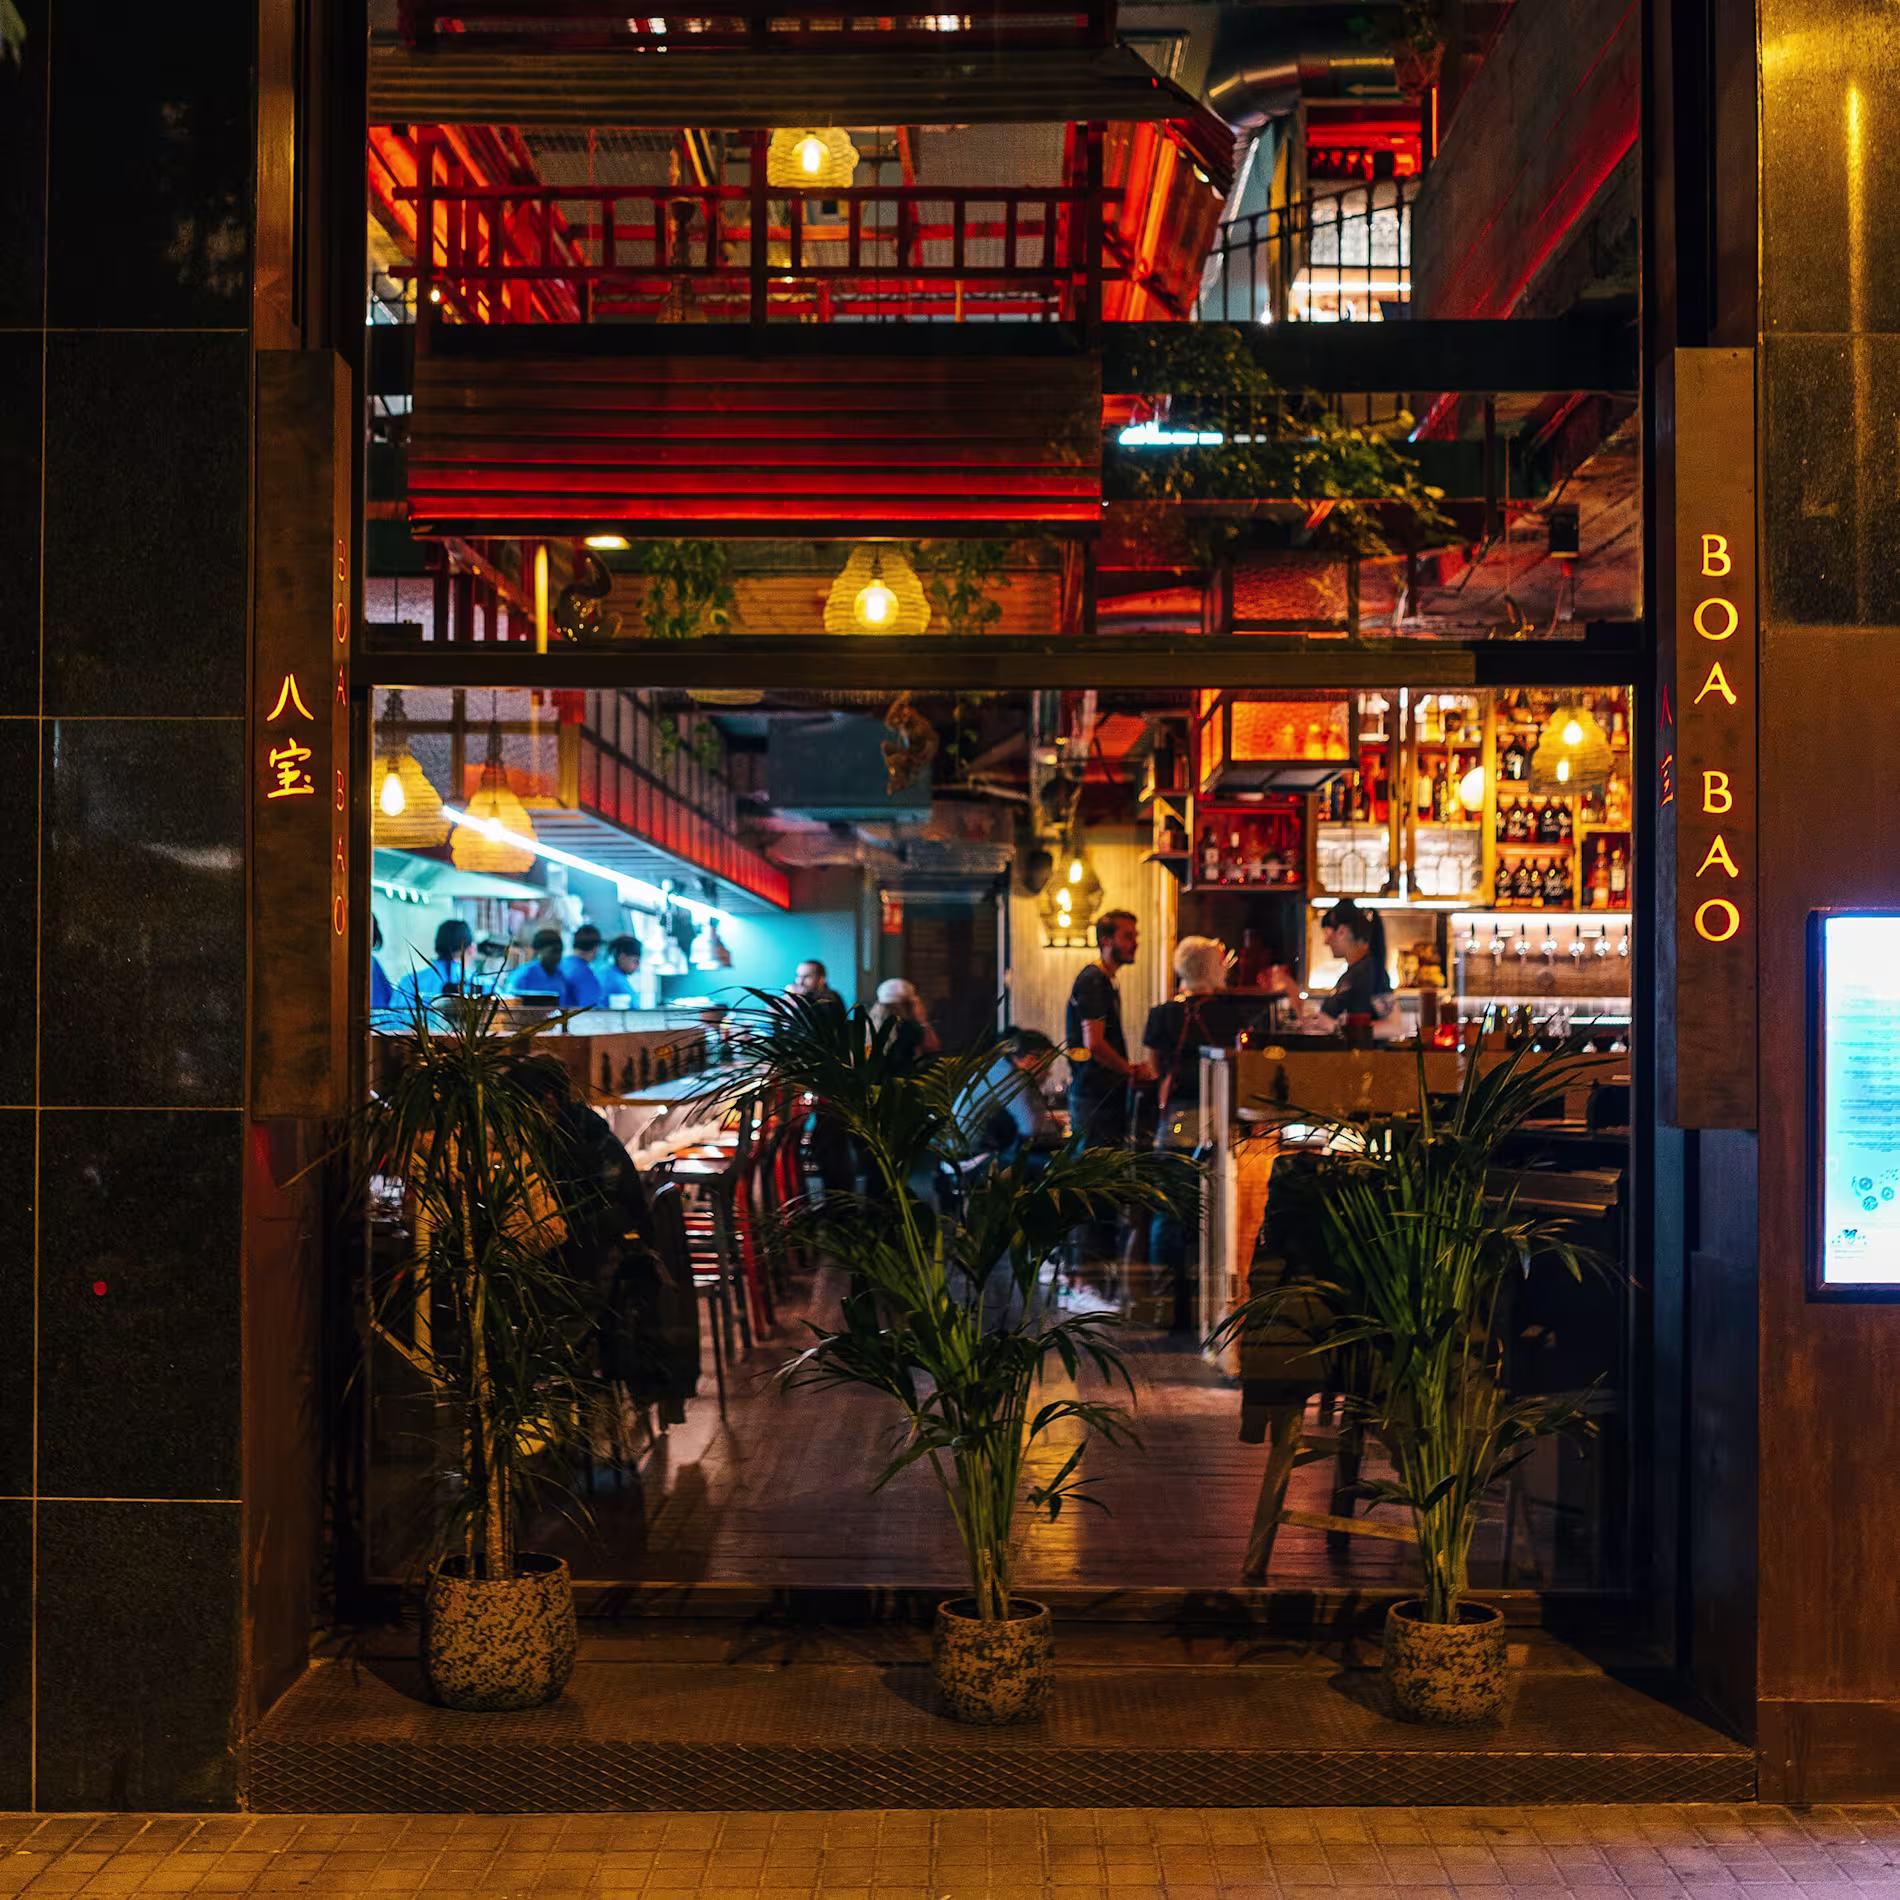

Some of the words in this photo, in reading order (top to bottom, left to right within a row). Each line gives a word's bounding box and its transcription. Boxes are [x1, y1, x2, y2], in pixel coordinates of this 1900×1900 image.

[334, 539, 348, 707] BOA
[1693, 534, 1739, 706] BOA
[266, 673, 315, 799] 八宝
[333, 769, 347, 937] BAO
[1695, 770, 1740, 942] BAO
